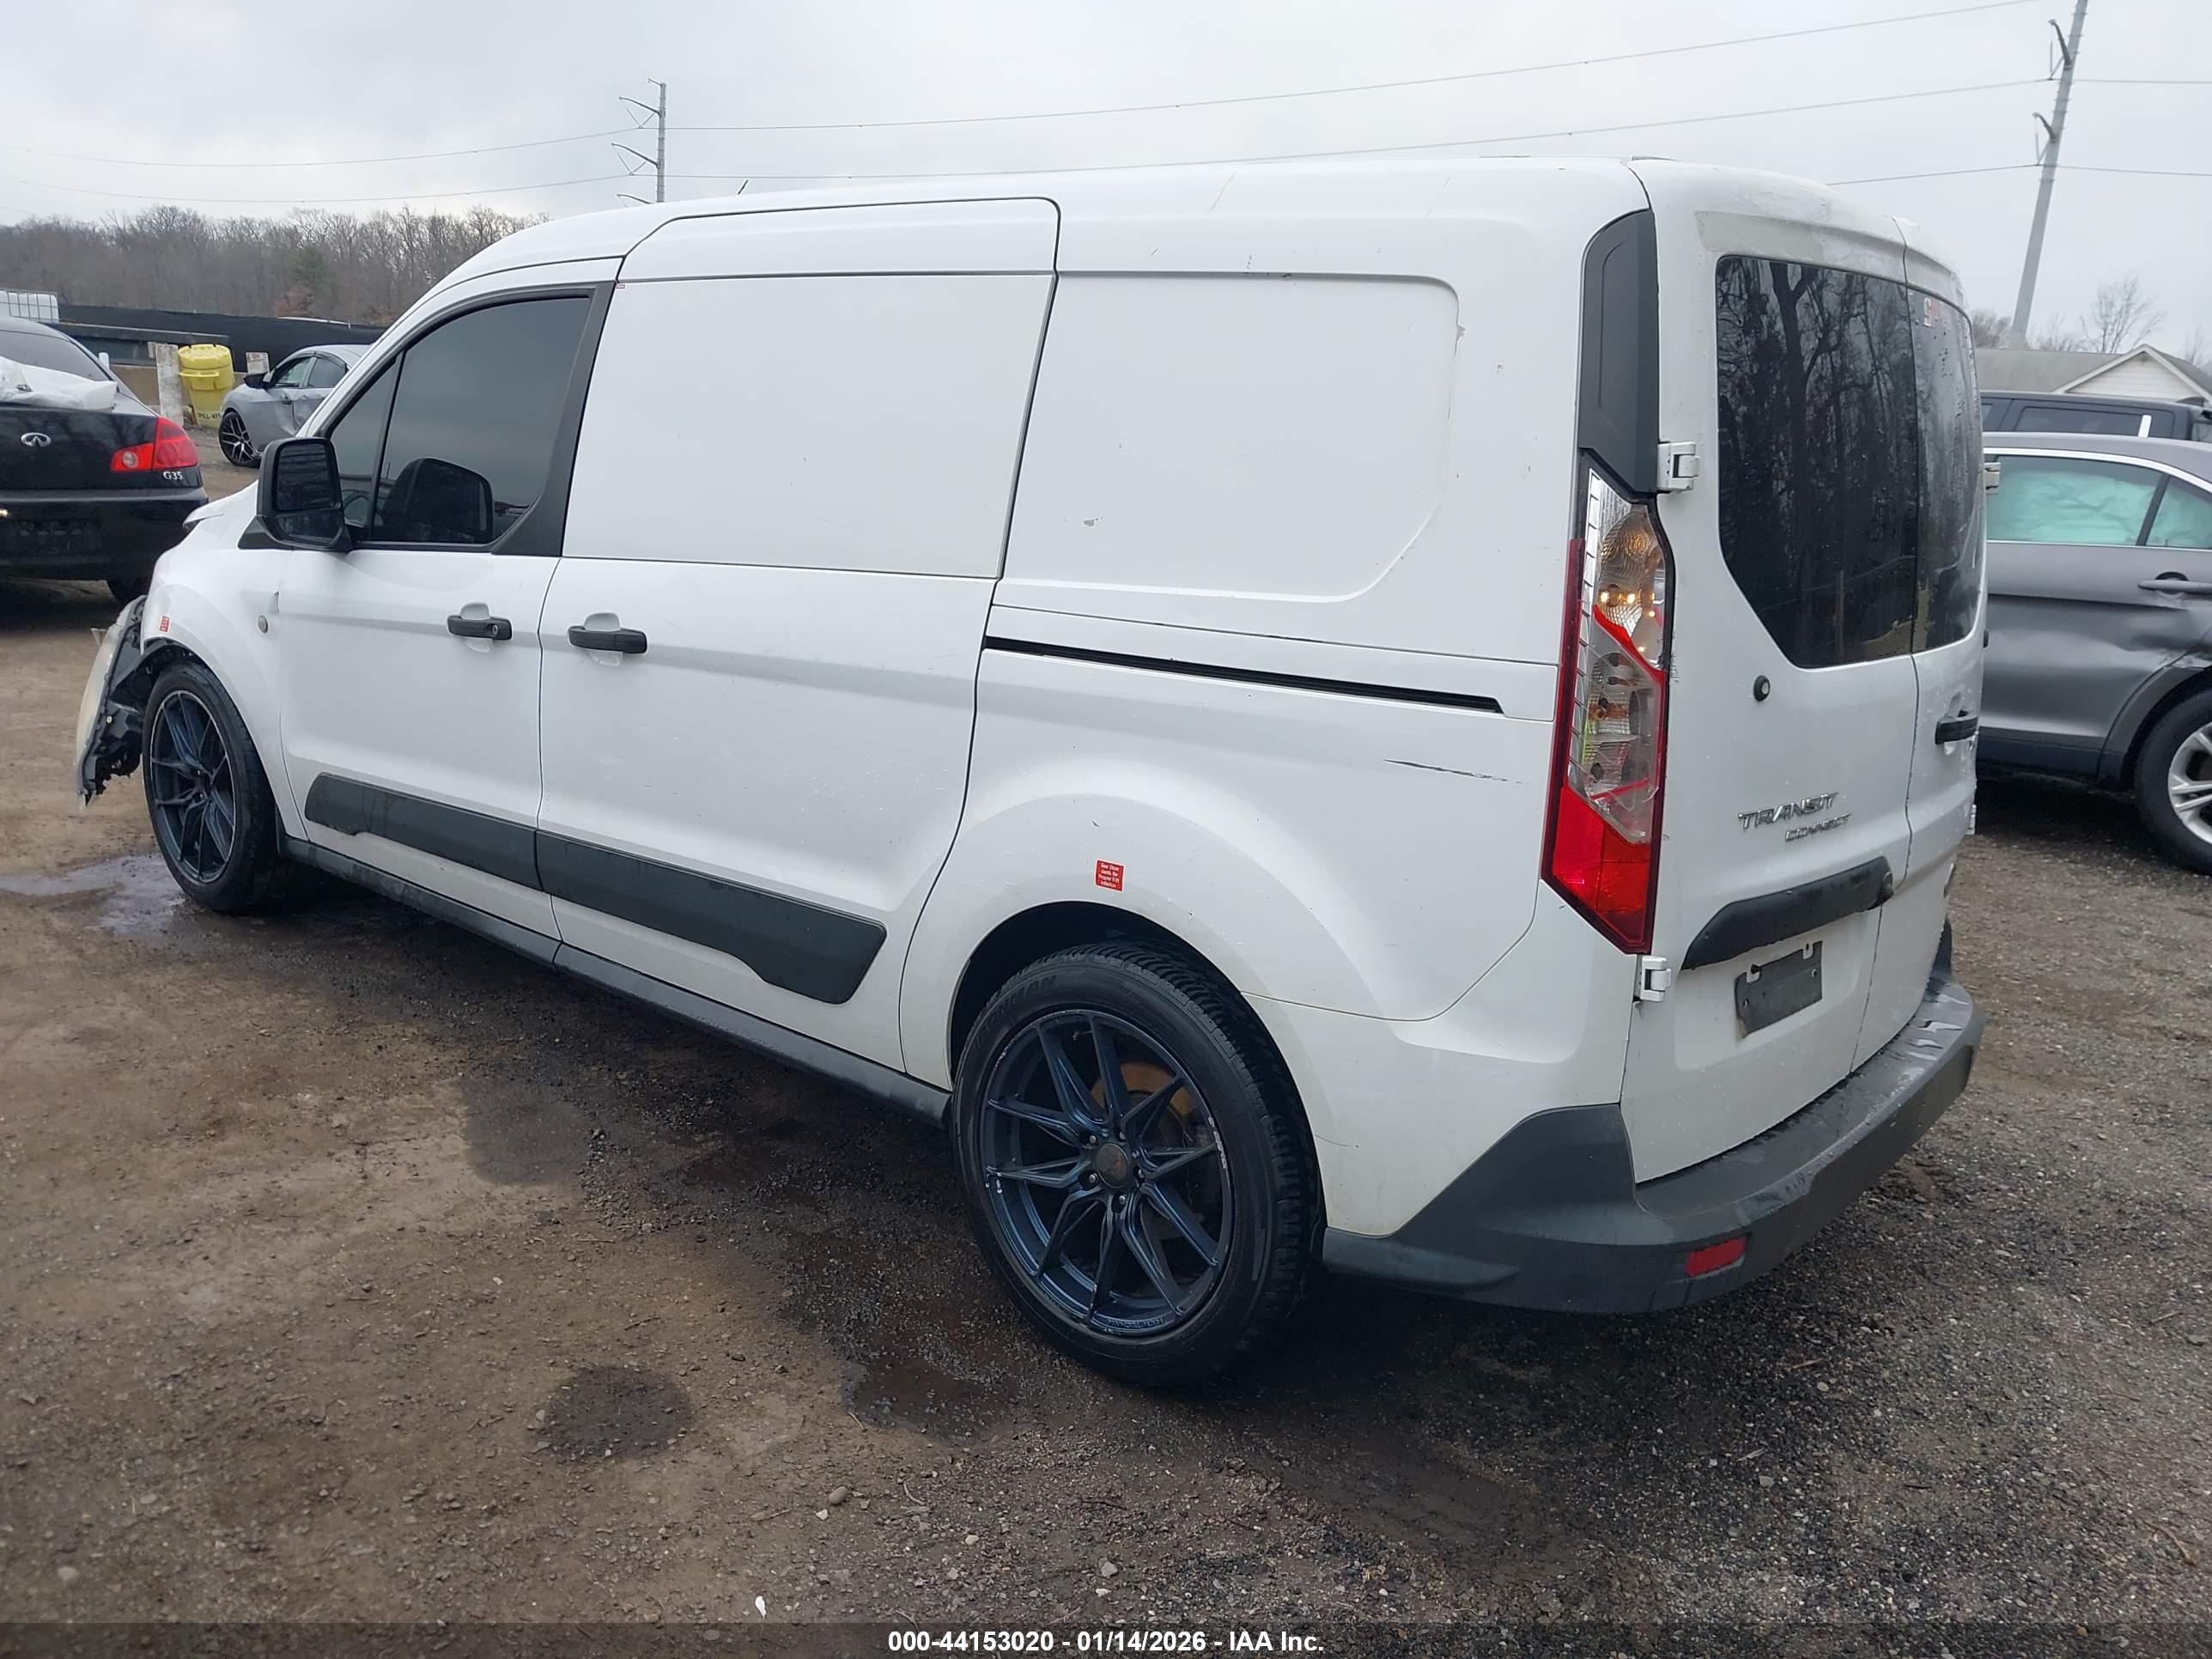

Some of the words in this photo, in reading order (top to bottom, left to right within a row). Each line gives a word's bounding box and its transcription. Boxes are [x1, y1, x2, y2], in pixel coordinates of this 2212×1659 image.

[163, 471, 183, 480] G35
[1738, 792, 1838, 830] TRANSIT
[1785, 813, 1851, 842] CONNECT
